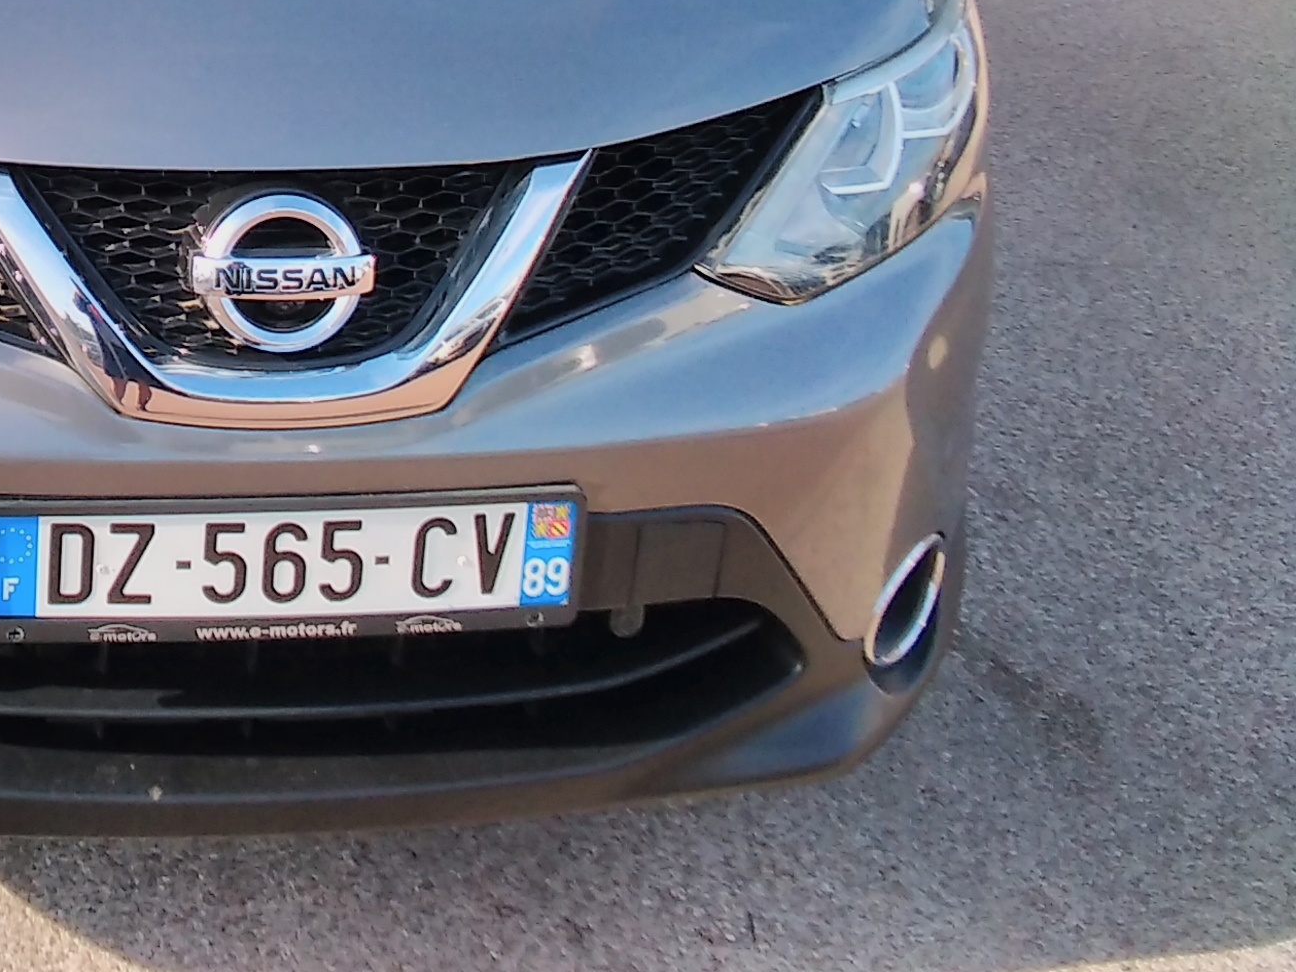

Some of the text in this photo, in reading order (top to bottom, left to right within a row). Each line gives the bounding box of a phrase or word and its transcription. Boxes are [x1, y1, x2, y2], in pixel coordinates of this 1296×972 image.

[214, 266, 356, 291] NISSAN
[46, 512, 516, 605] DZ-565-CV
[2, 577, 20, 601] F
[522, 557, 571, 598] 89
